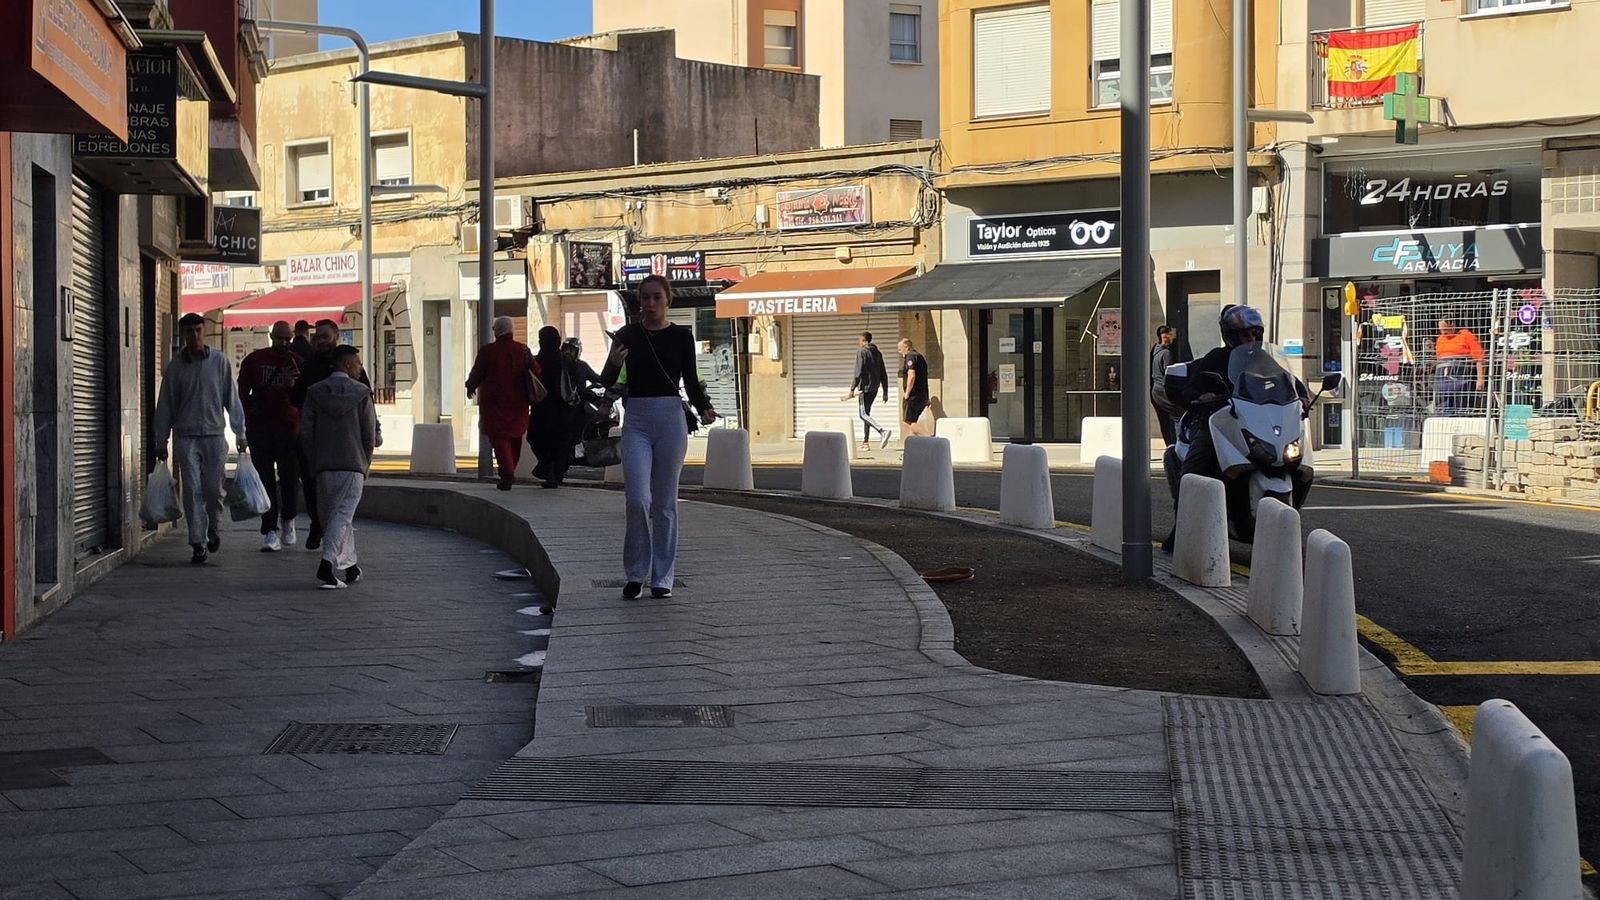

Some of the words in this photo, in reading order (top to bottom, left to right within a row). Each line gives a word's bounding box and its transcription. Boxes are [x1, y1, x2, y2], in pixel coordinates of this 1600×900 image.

[127, 59, 171, 74] ACION
[129, 103, 166, 114] NAJE
[78, 141, 170, 153] EDREDONES
[1360, 177, 1411, 205] 24
[1413, 180, 1509, 201] HORAS
[976, 222, 1022, 243] Taylor
[997, 241, 1021, 249] Audición
[1021, 240, 1037, 248] desde
[179, 264, 204, 275] BAZAR
[291, 257, 322, 274] BAZAR
[324, 254, 356, 272] CHINO
[748, 297, 838, 315] PASTELERIA
[1359, 373, 1374, 381] 24
